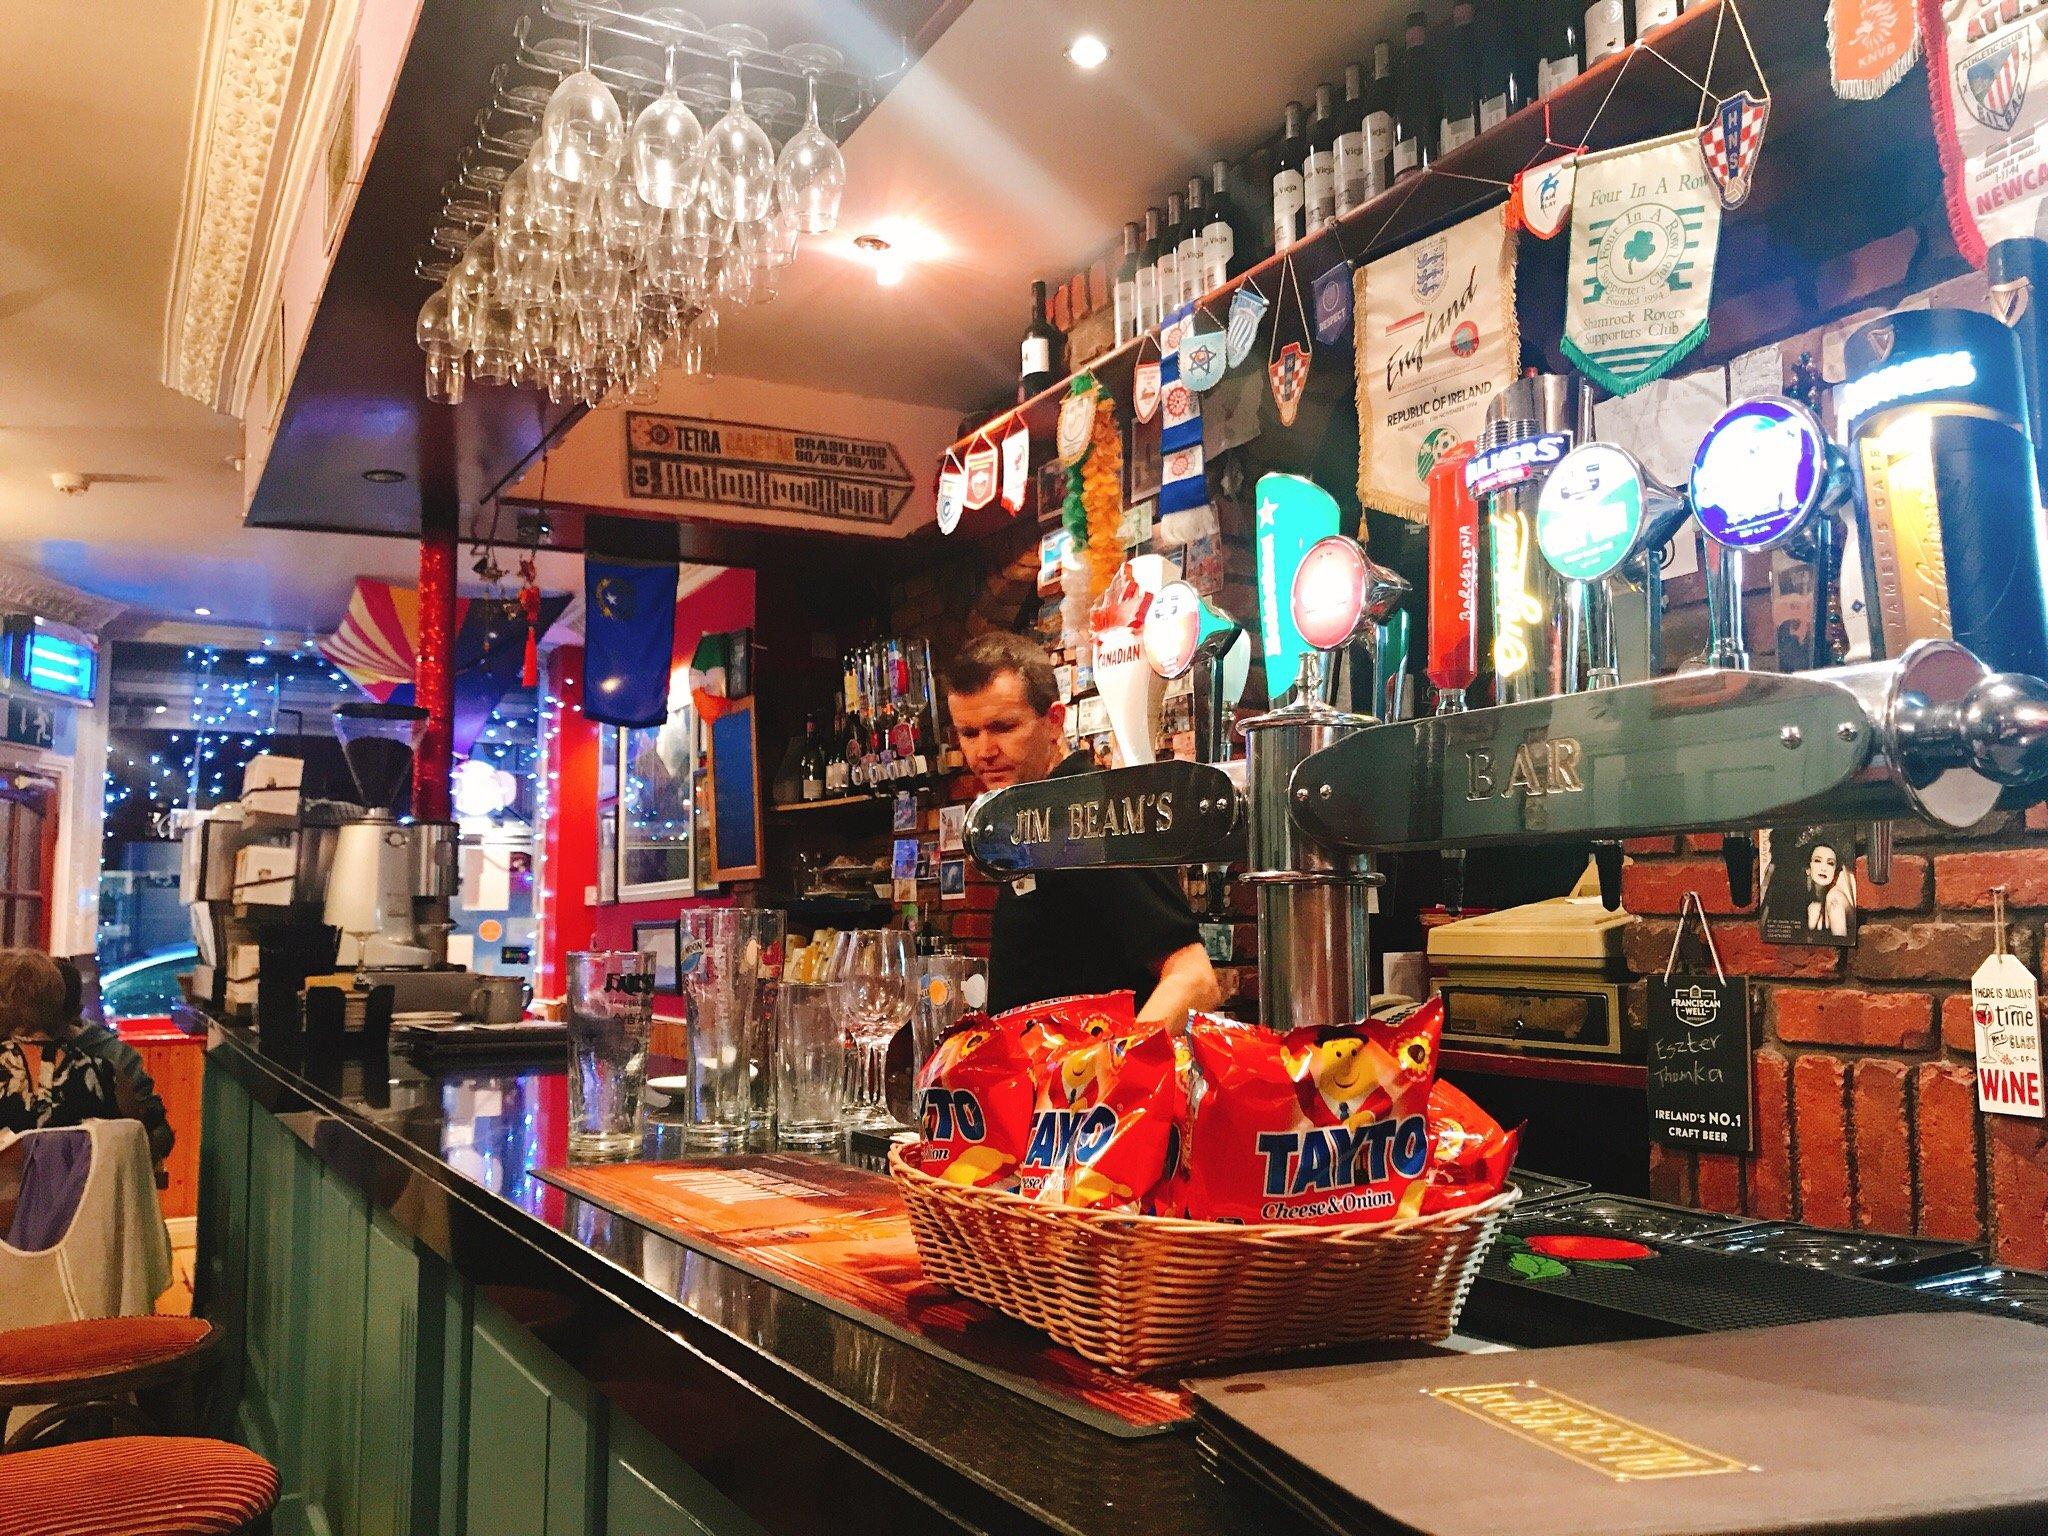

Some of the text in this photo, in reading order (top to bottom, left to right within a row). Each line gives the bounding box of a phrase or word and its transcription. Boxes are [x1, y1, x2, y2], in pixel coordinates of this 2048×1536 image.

[1857, 42, 1896, 69] KNVB
[1962, 31, 2023, 70] ATHLETIC CLUB
[1728, 109, 1739, 169] HNS
[1589, 188, 1622, 208] Four
[1629, 182, 1646, 199] In
[1655, 176, 1668, 195] A
[1600, 208, 1679, 260] Four In A Row
[1649, 260, 1672, 286] Club
[1318, 306, 1347, 333] RESPECT
[1386, 265, 1478, 392] England
[1583, 308, 1686, 332] Shamrock Rovers
[1583, 321, 1680, 346] Supporters Club
[1386, 380, 1493, 427] REPUBLIC OF IRELAND
[674, 426, 722, 454] TETRA
[794, 437, 888, 458] BRASILEIRO
[1097, 643, 1141, 667] CANADIAN
[1465, 736, 1584, 801] BAR
[1010, 791, 1174, 846] JIM BEAM'S
[1671, 998, 1721, 1008] FRANCISCAN
[1974, 987, 2033, 999] THERE IS ALWAYS
[1685, 1007, 1707, 1016] WELL
[1995, 1005, 2035, 1027] time
[1656, 1031, 1721, 1060] Eszter
[1979, 1068, 2040, 1107] WINE
[1655, 1109, 1741, 1128] IRELAND'S NO.1
[1668, 1126, 1728, 1143] CRAFT BEER
[1256, 1113, 1429, 1198] TAYTO
